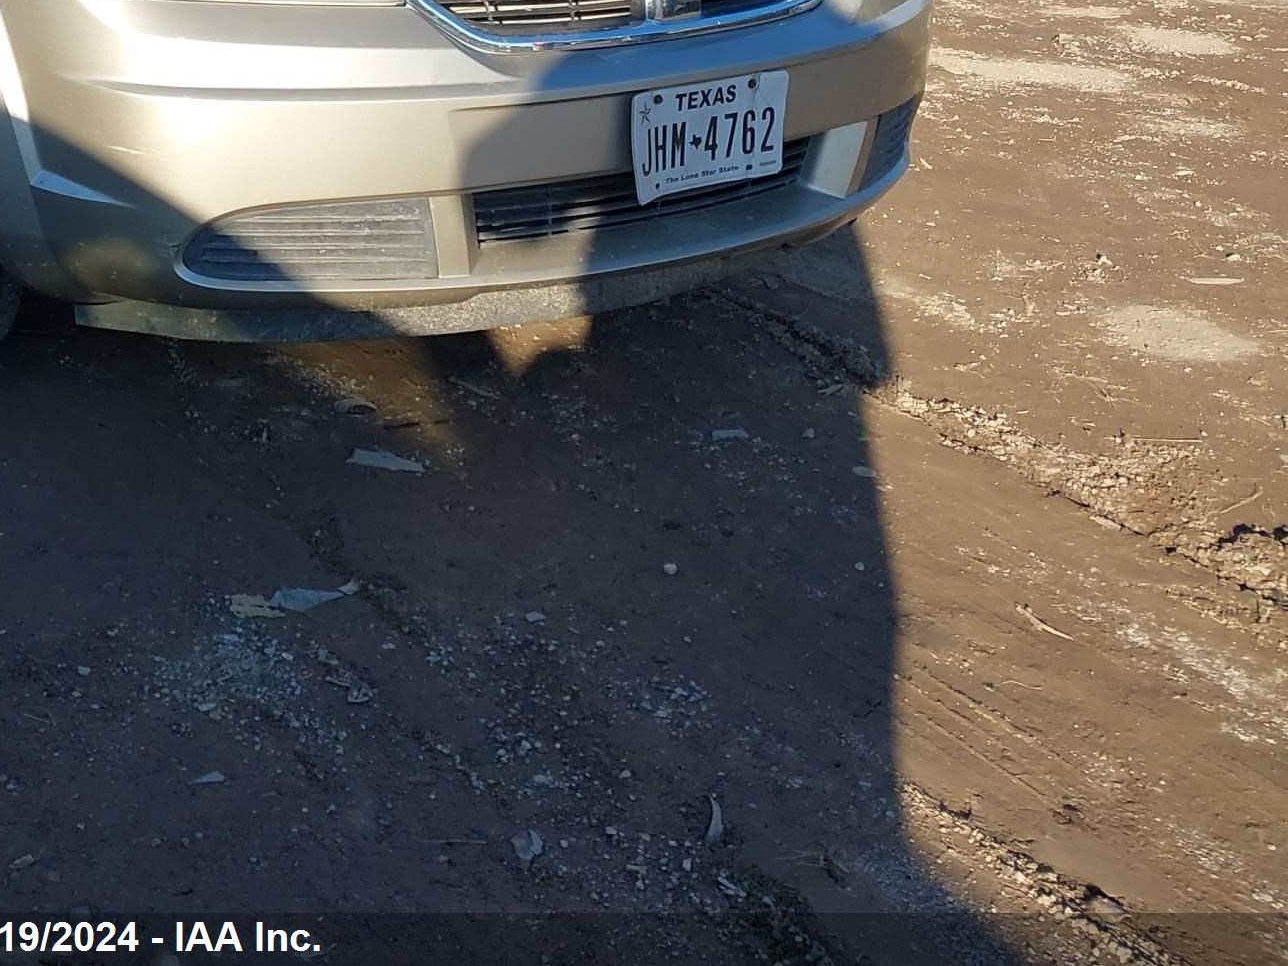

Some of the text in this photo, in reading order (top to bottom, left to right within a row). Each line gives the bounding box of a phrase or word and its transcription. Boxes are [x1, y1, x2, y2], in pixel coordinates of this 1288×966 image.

[676, 85, 737, 111] TEXAS
[681, 172, 699, 181] Lone
[701, 169, 717, 177] Star
[719, 165, 739, 174] State
